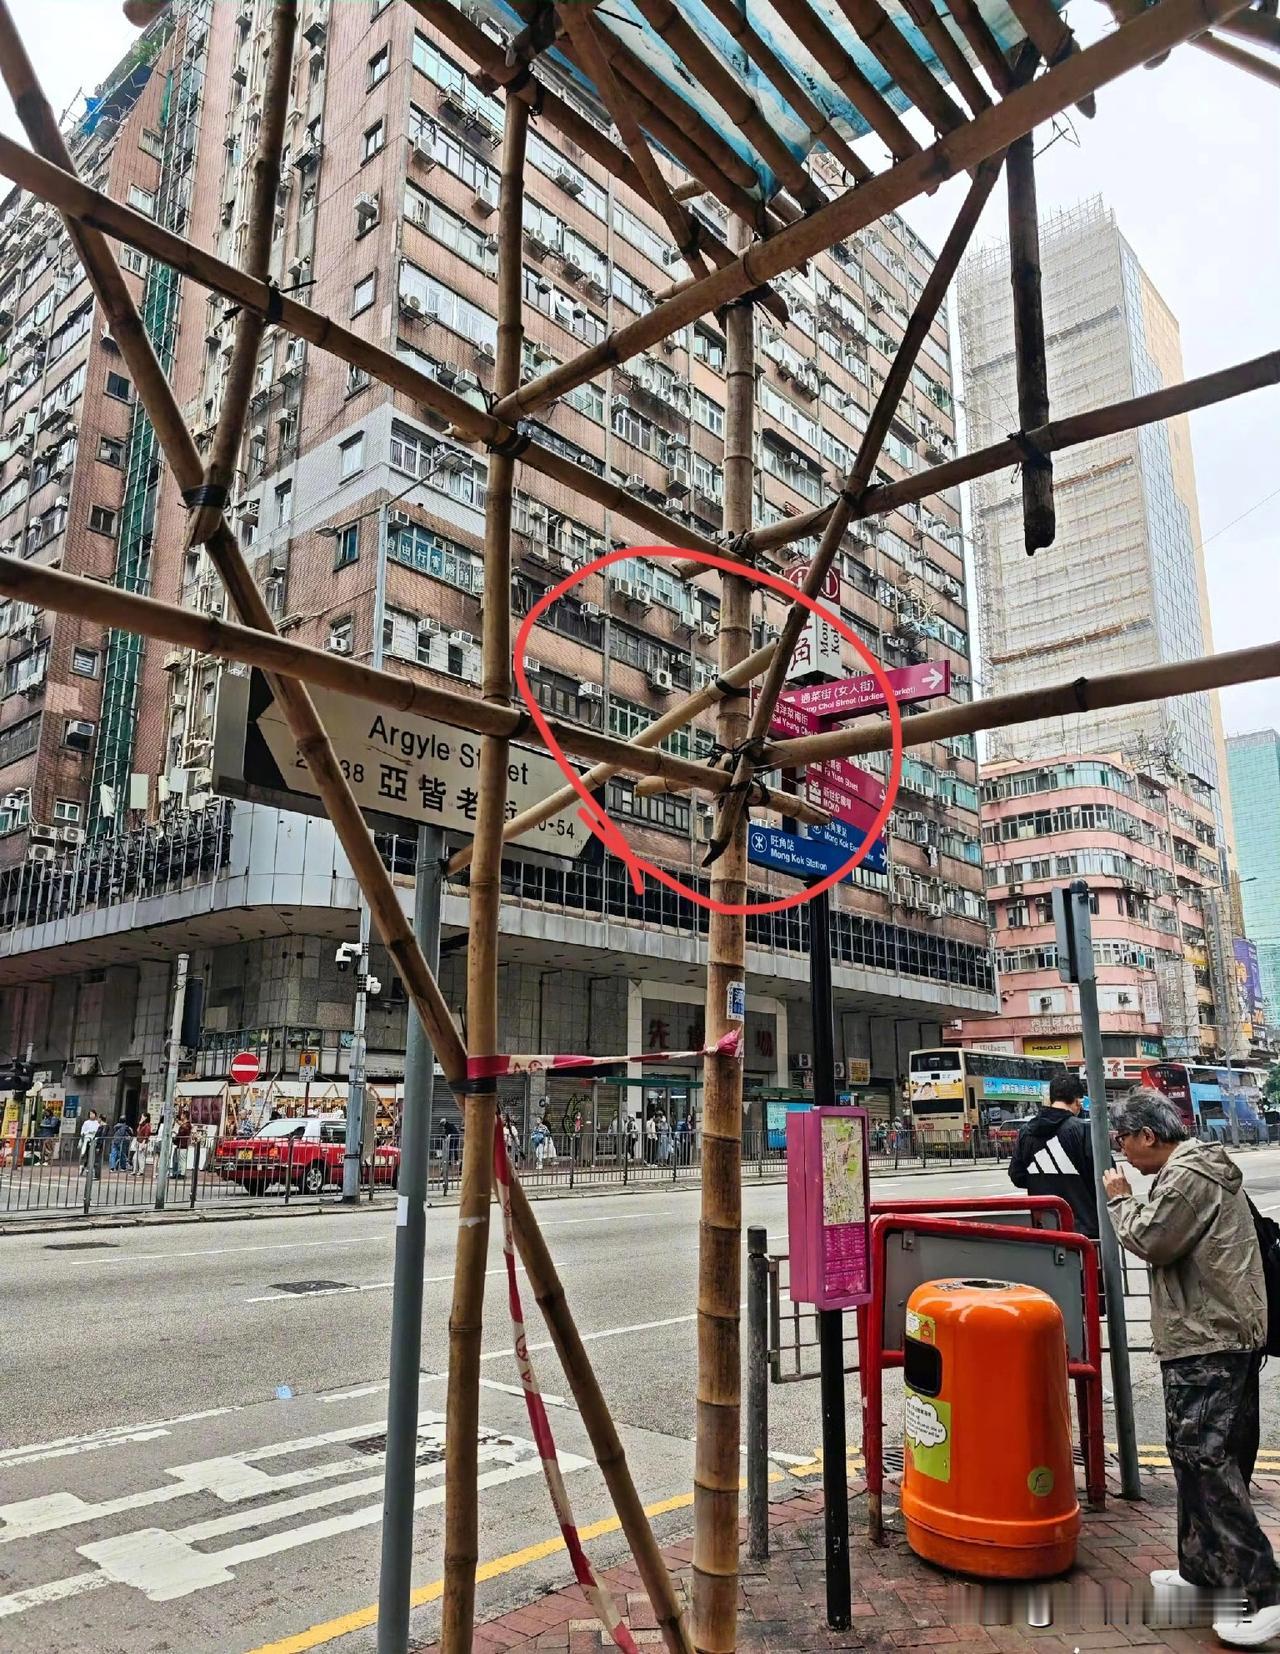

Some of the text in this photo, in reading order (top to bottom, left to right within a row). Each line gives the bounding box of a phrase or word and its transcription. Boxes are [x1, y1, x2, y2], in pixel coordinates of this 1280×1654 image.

[820, 618, 829, 658] Mon
[800, 688, 832, 704] 通菜街
[368, 715, 528, 785] Argyle Stet
[533, 818, 575, 839] 0-54
[770, 835, 794, 851] 旺角站
[770, 848, 828, 871] Mong Kok Station
